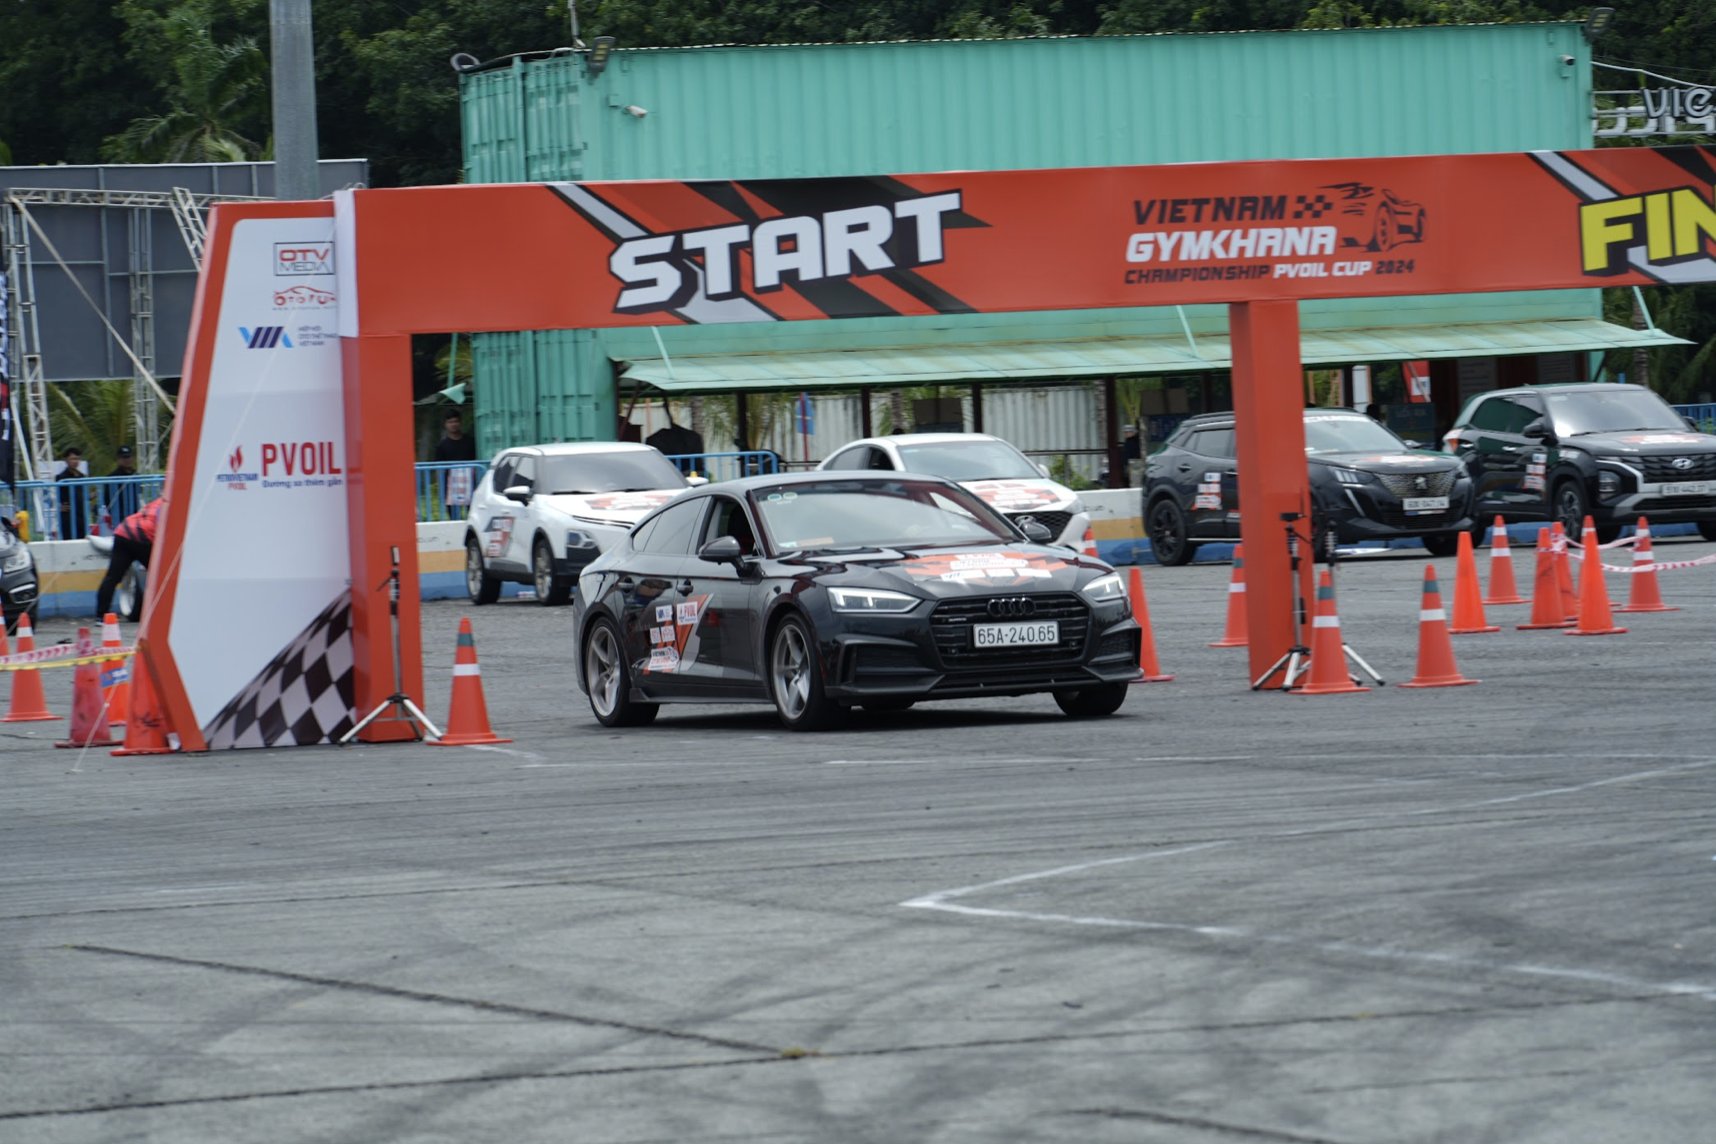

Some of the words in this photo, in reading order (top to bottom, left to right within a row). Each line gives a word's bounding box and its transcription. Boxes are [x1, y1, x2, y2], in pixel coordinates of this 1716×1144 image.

[1134, 195, 1288, 225] VIETNAM
[279, 248, 330, 261] OTV
[610, 193, 961, 308] START
[1126, 226, 1337, 263] GYMKHANA
[1124, 264, 1271, 284] CHAMPIONSHIP
[1273, 262, 1329, 279] PVOIL
[1332, 261, 1373, 277] CUP
[1375, 259, 1415, 275] 2024
[261, 441, 342, 477] PVOIL
[978, 625, 1055, 645] 65A-240.65
